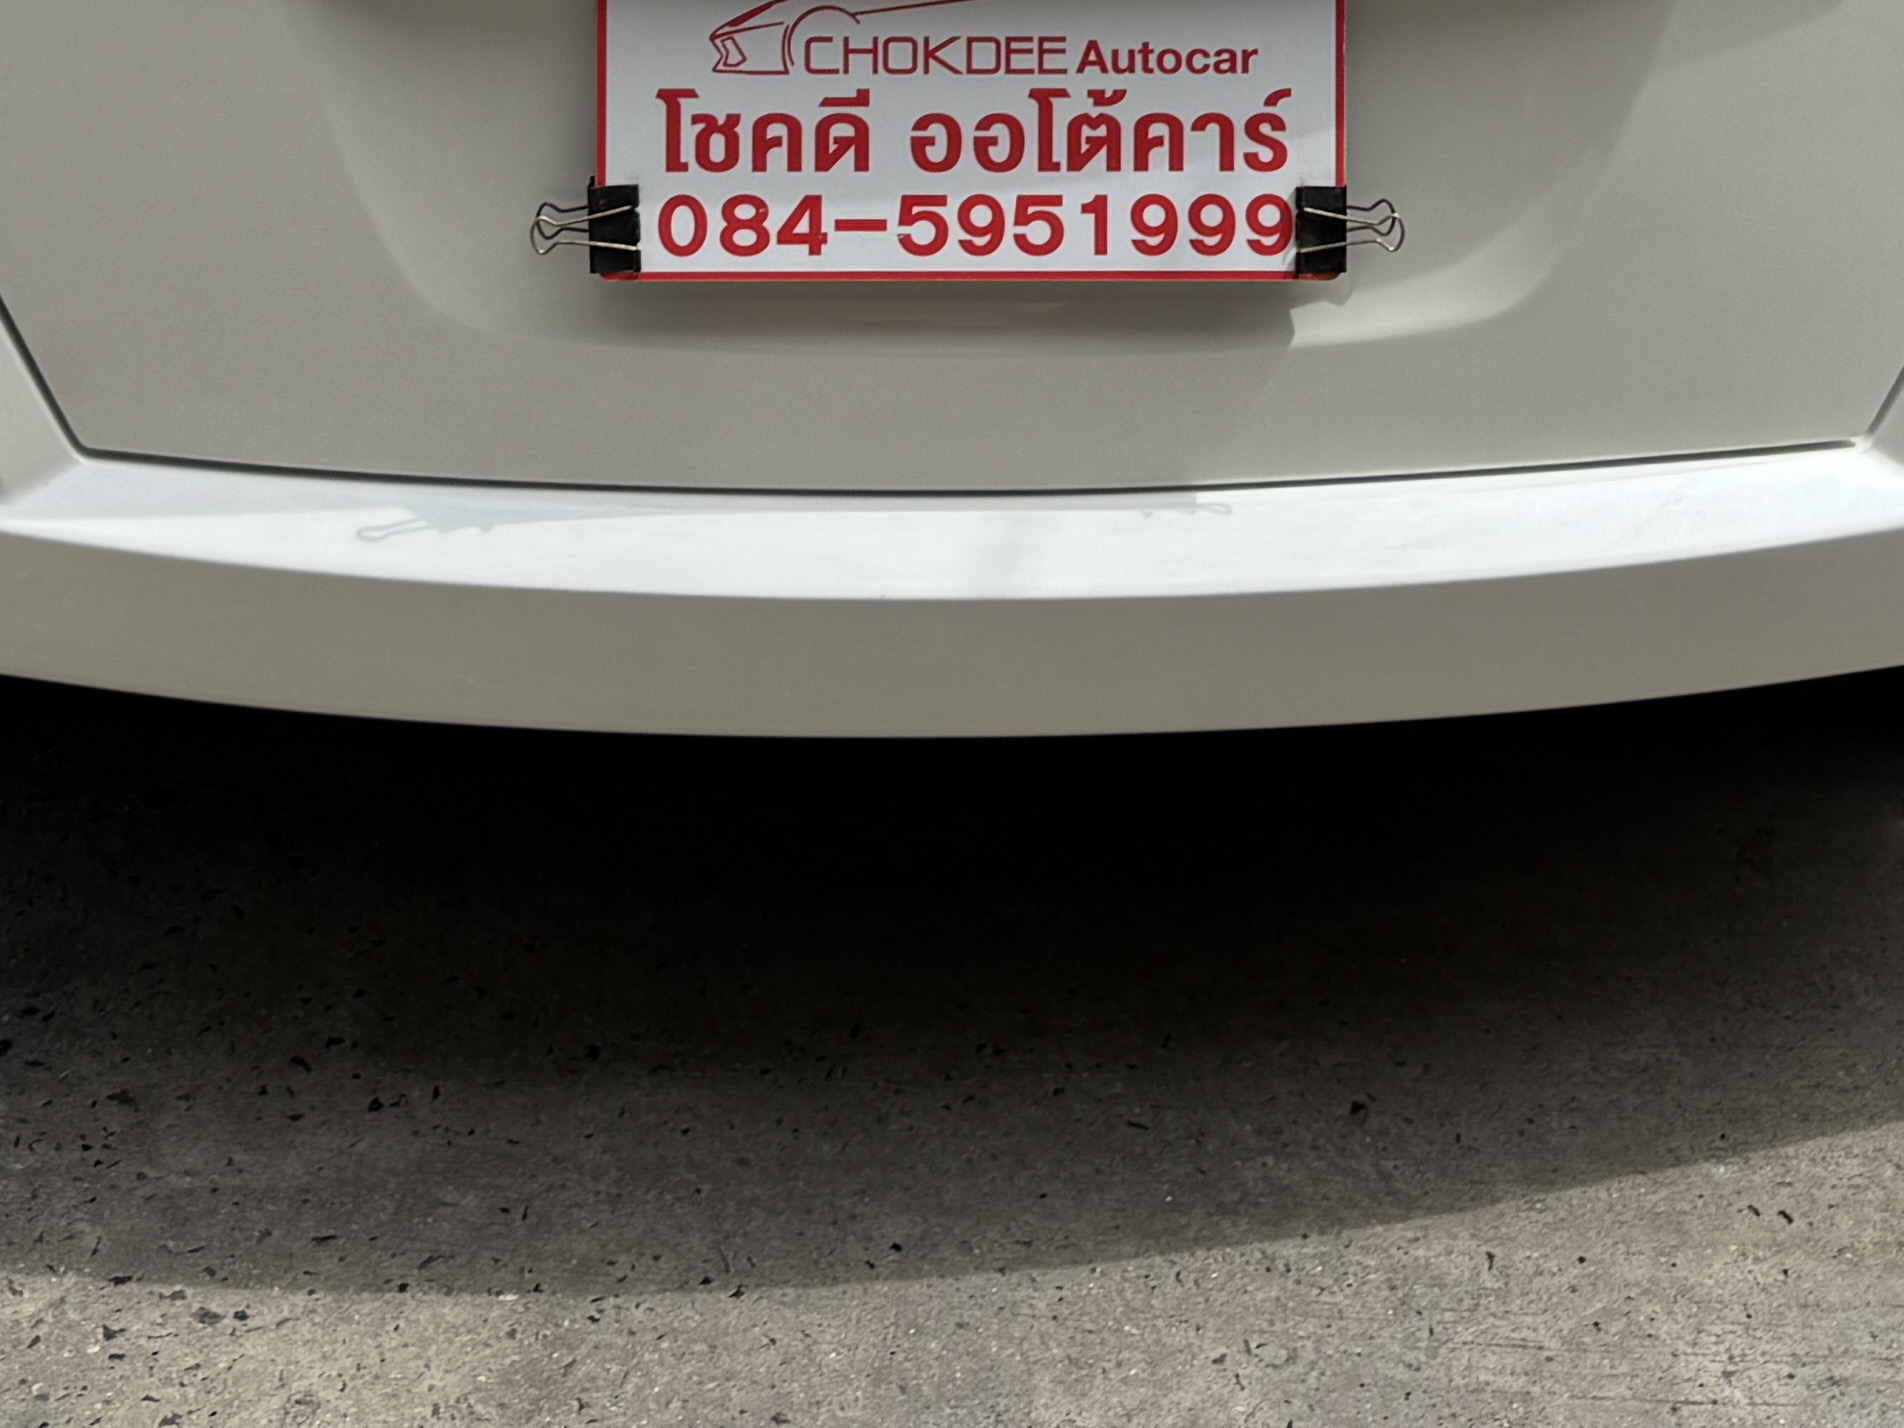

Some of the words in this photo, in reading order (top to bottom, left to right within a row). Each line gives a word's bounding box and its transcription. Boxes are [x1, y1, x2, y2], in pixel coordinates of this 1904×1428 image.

[804, 36, 1069, 75] CHOKDEE
[1075, 38, 1259, 75] Autocar
[656, 87, 873, 173] โชคดี
[908, 87, 1294, 173] ออโต้คาร์
[656, 193, 1295, 258] 084-5951999
